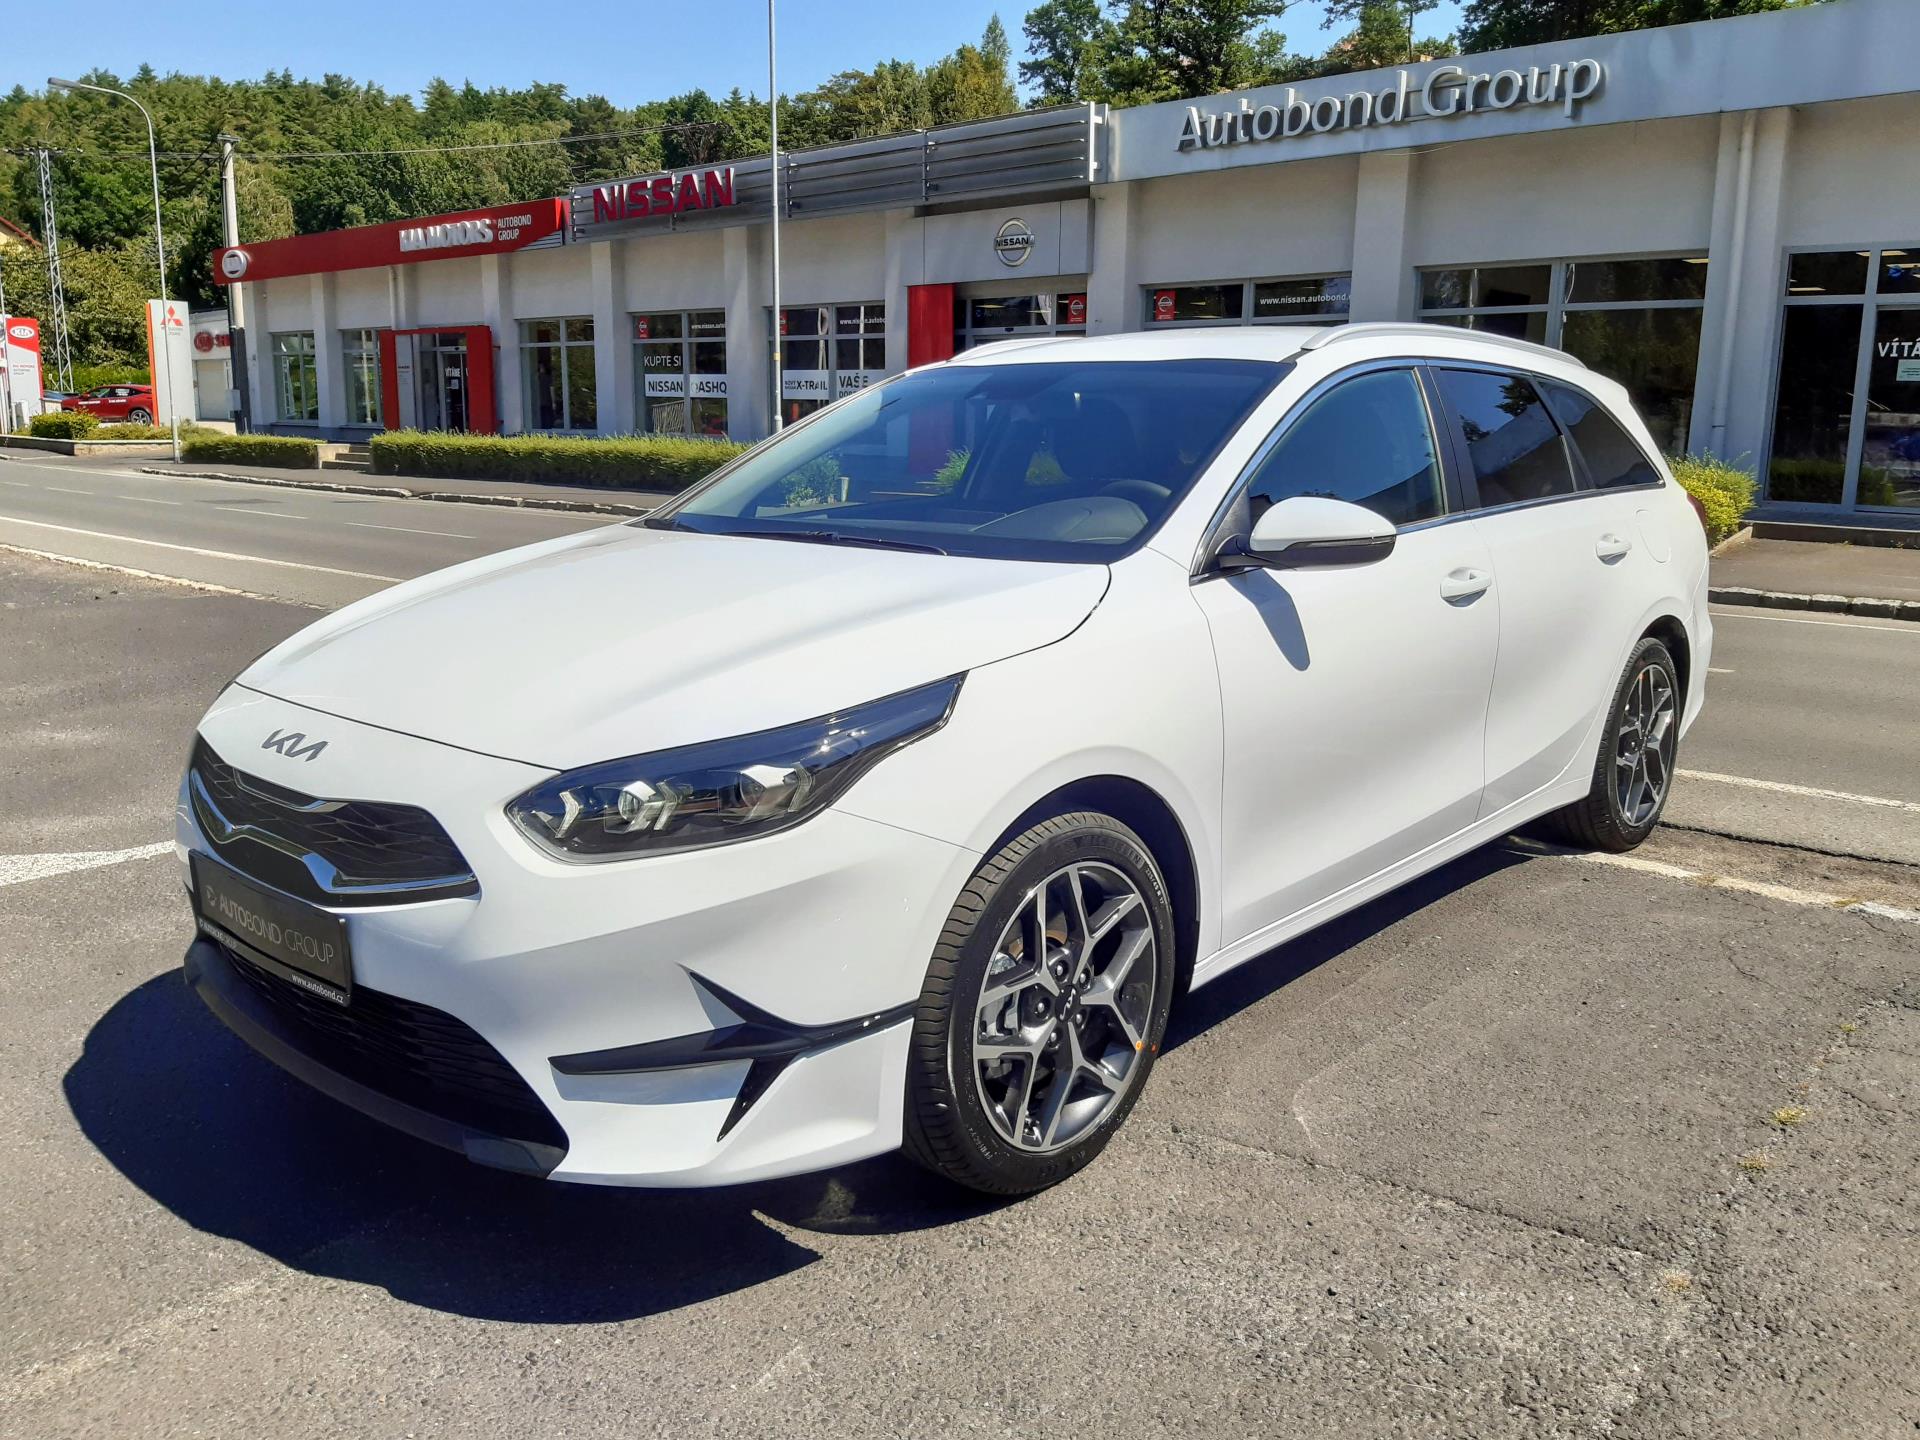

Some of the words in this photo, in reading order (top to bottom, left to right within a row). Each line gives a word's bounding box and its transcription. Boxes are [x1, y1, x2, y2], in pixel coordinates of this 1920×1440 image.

[1177, 70, 1407, 152] Autobond
[1422, 58, 1600, 118] Group
[593, 167, 735, 224] NISSAN
[497, 214, 532, 229] AUTOBOND
[427, 218, 494, 249] MOTORS
[498, 228, 520, 241] GROUP
[995, 237, 1030, 248] NISSAN
[1259, 293, 1350, 305] www.nissan.autobond.
[644, 355, 671, 367] KUPTE
[673, 355, 682, 367] SI
[648, 381, 683, 393] NISSAN
[796, 380, 828, 391] X-TRAIL
[839, 372, 868, 389] VAŠE
[220, 893, 282, 944] AUTOBOND
[285, 929, 334, 964] GROUP
[292, 974, 345, 1004] www.autobond.cz
